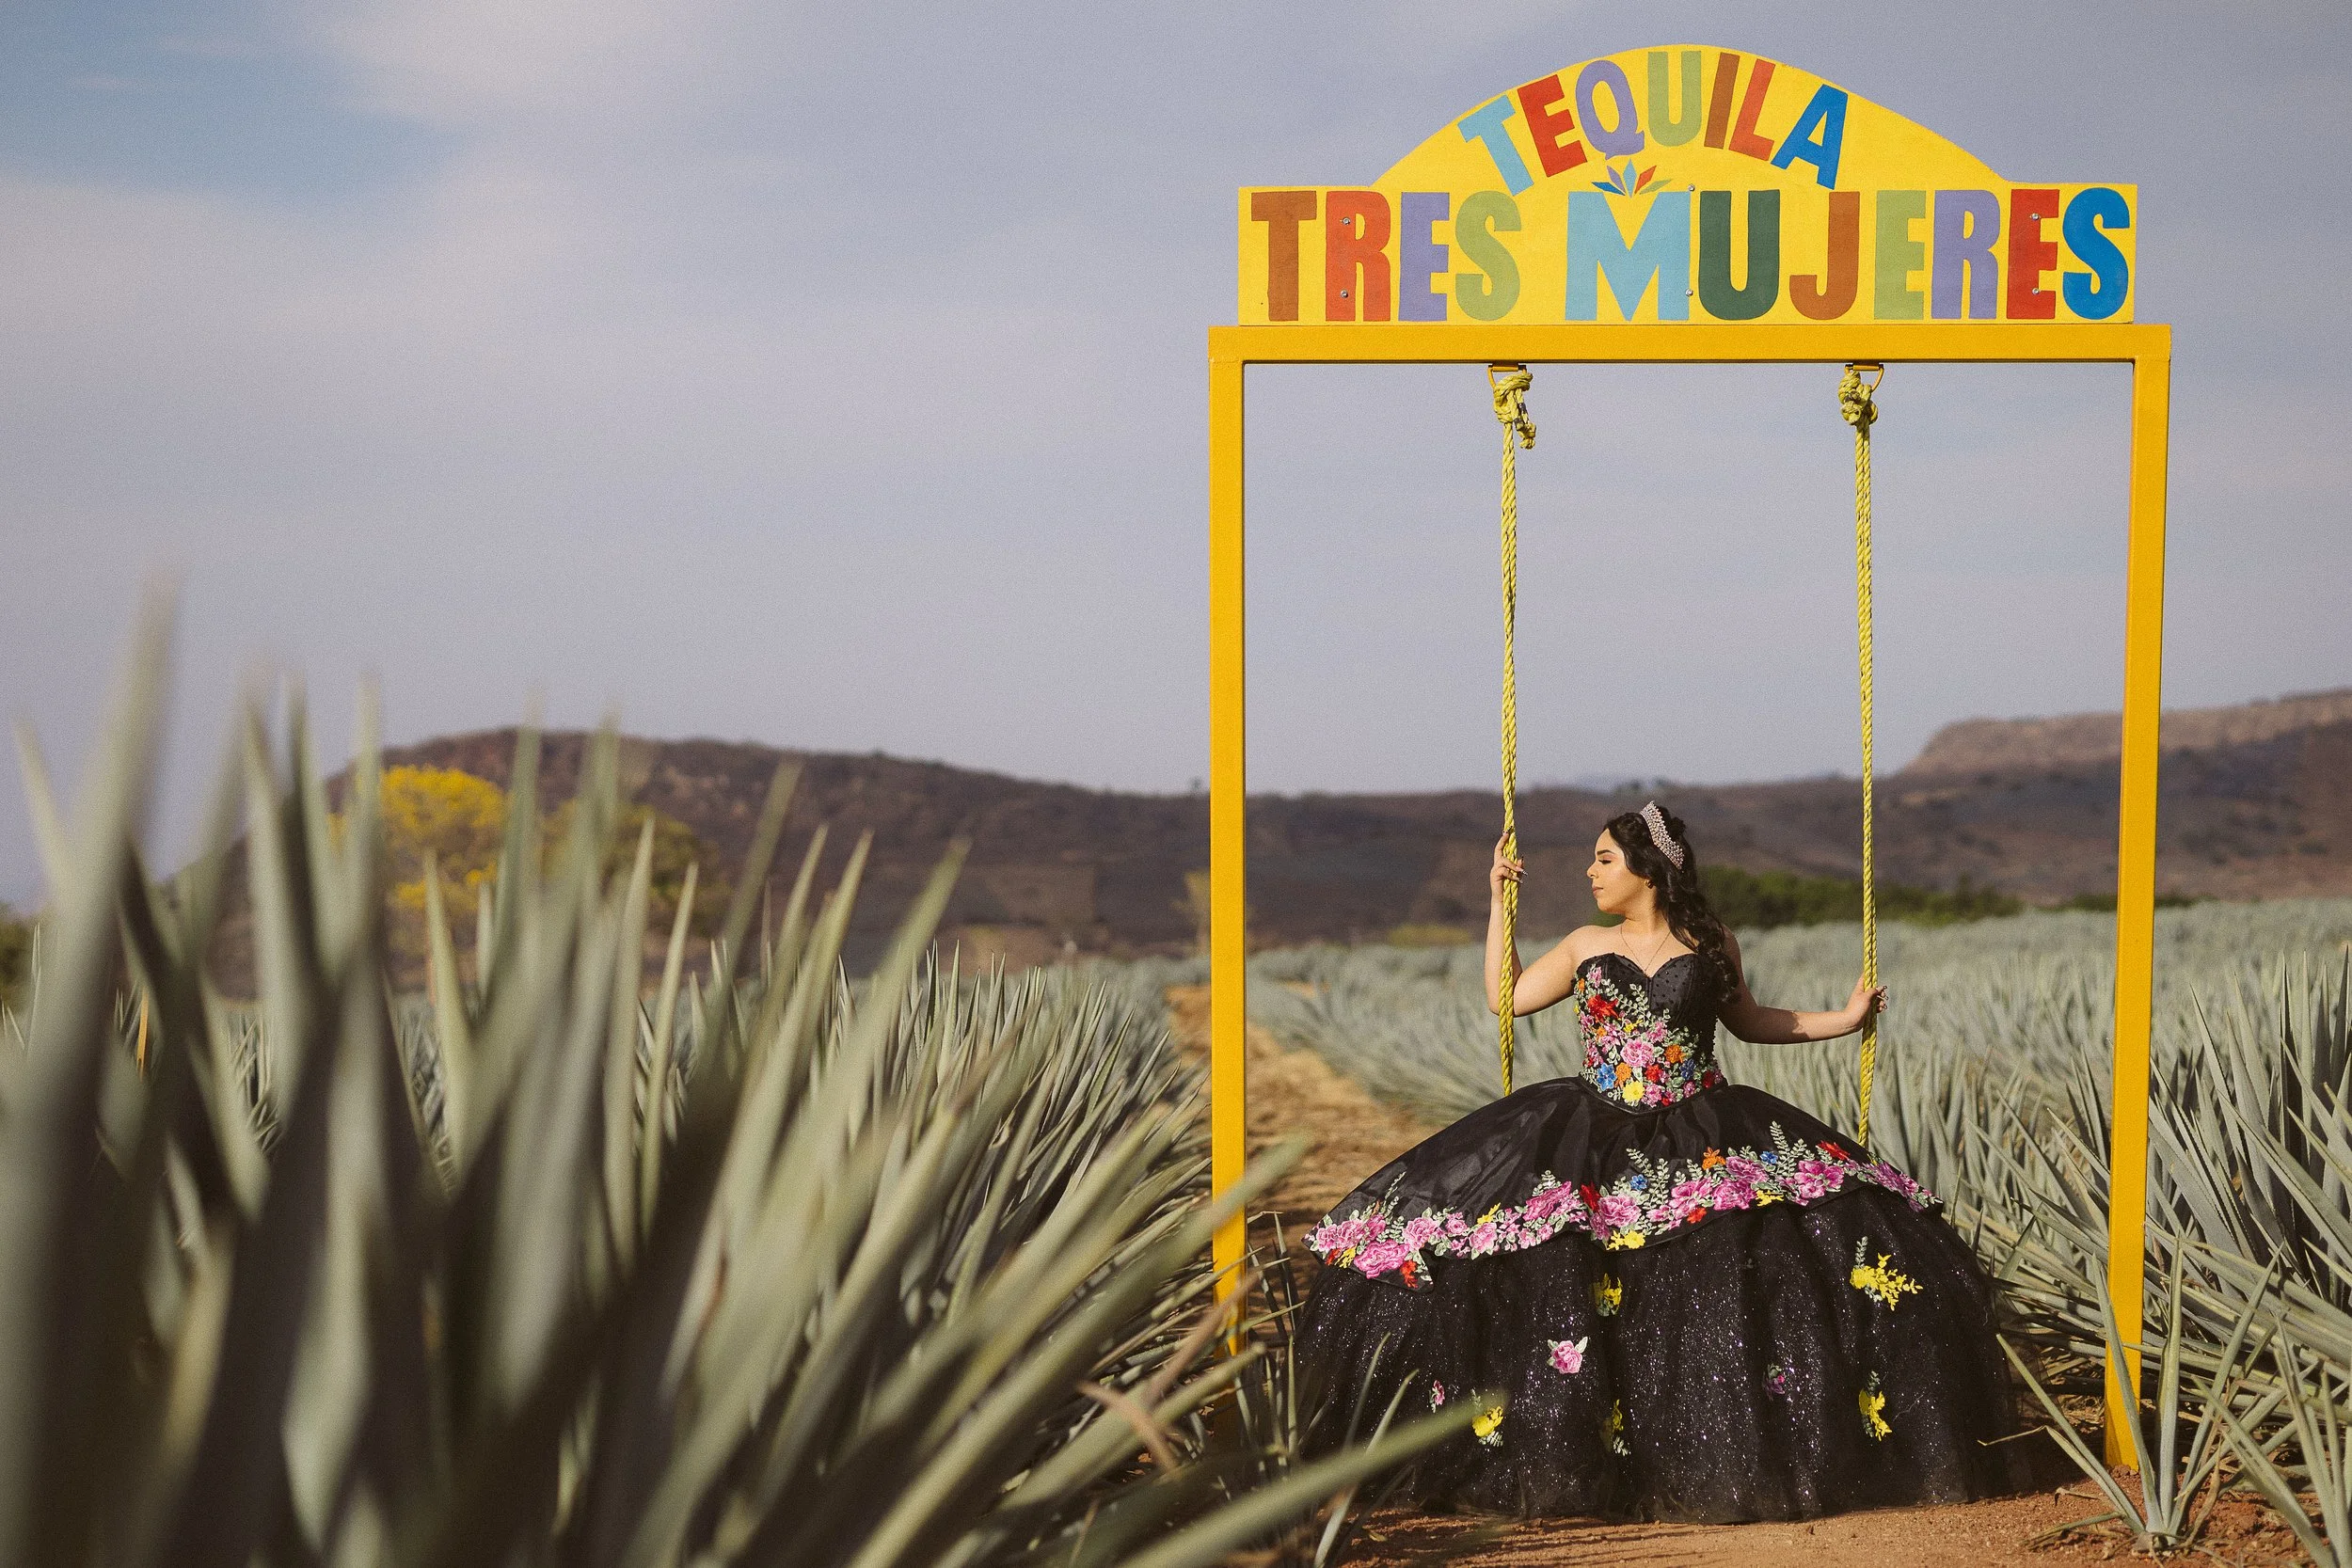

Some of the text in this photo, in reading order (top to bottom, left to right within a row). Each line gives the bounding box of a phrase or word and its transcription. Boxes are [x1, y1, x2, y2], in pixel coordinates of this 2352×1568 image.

[1457, 50, 1849, 196] TEQUILA
[1250, 187, 2131, 322] TRES MUJERES
